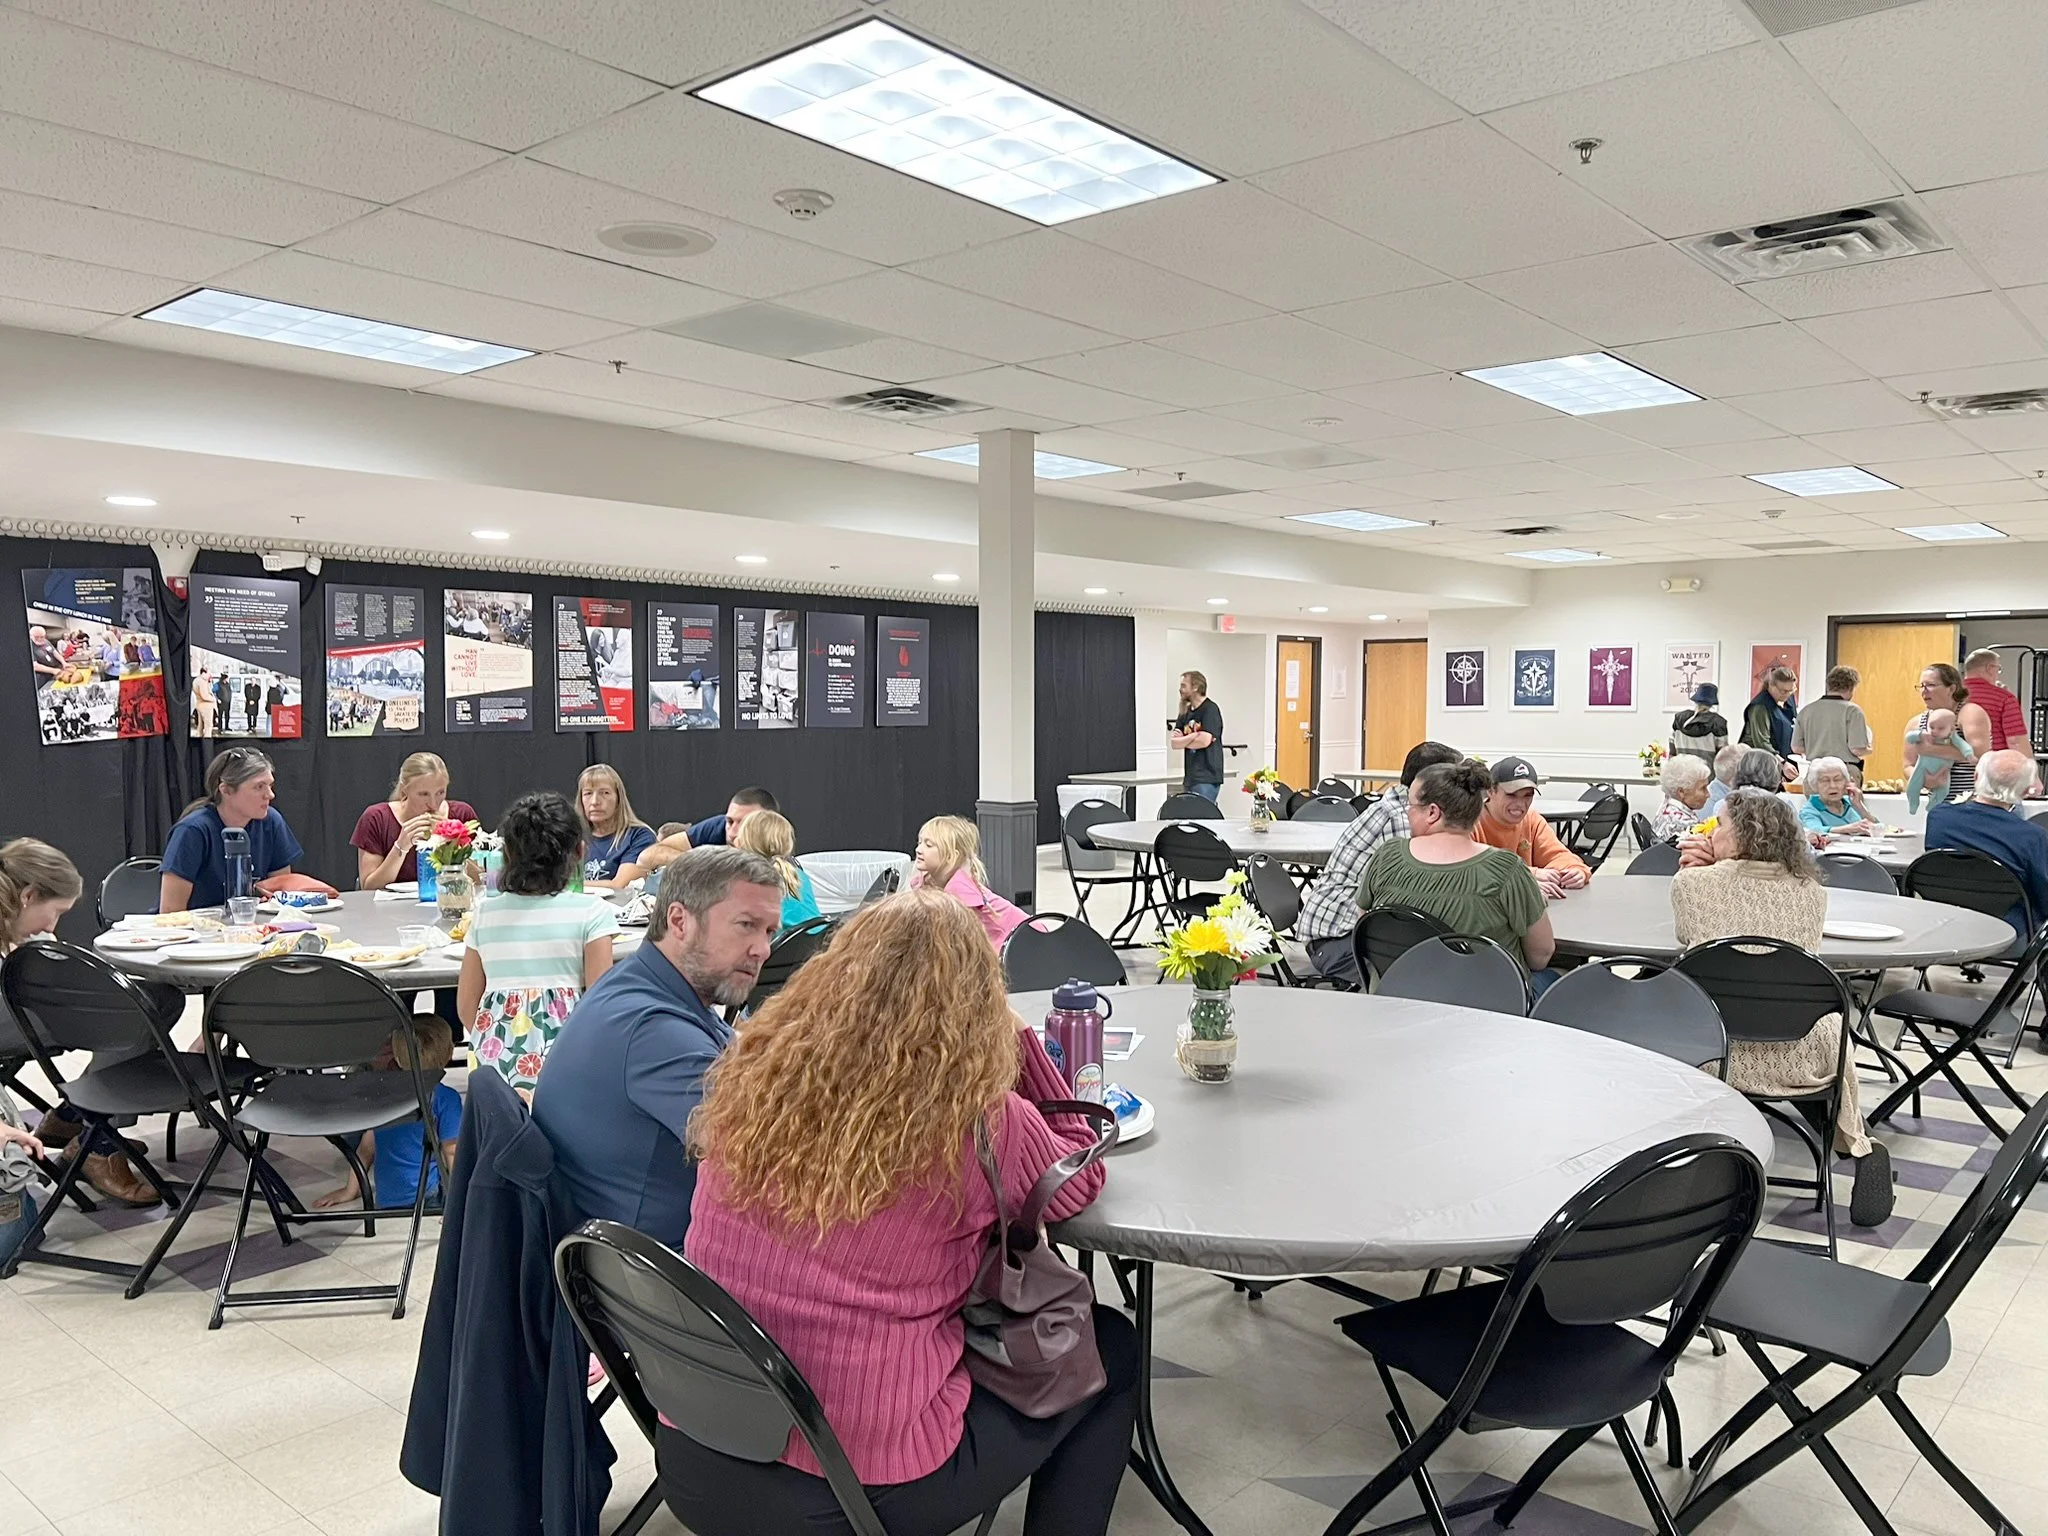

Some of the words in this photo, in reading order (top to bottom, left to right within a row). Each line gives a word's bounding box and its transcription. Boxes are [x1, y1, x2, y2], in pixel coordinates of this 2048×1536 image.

[204, 586, 226, 594] MEETING
[828, 644, 855, 657] DOING
[560, 715, 569, 723] NO
[569, 715, 581, 723] ONE
[741, 712, 750, 720] NO
[751, 712, 769, 720] LIMITS
[770, 711, 778, 720] TO
[778, 711, 793, 720] LOVE
